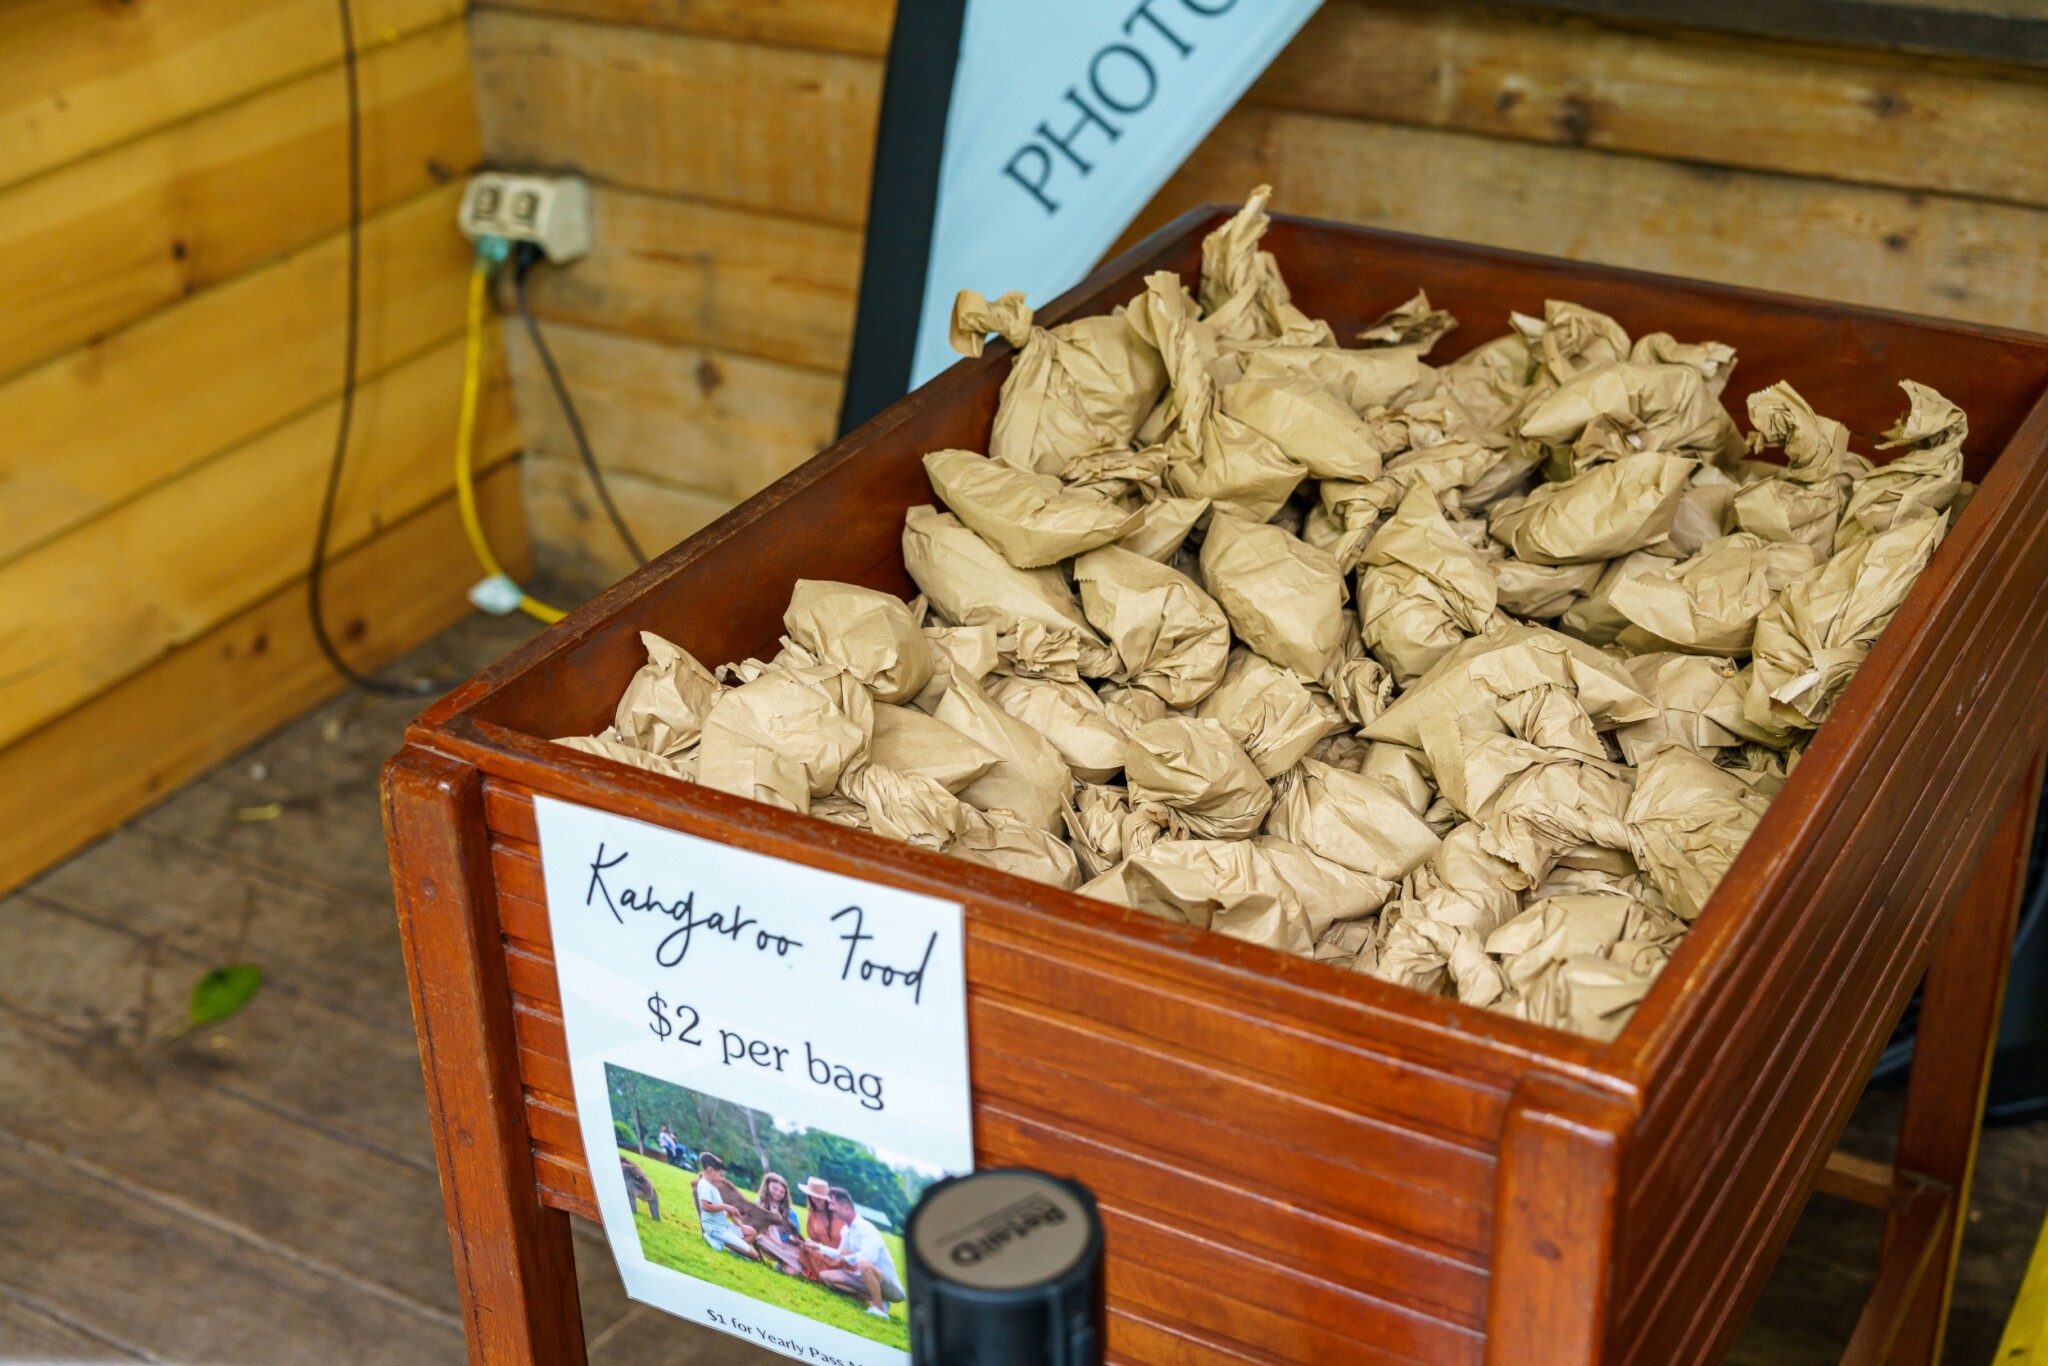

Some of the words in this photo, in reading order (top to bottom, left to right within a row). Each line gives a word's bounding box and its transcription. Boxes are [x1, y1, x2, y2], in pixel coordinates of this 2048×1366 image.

[1001, 0, 1241, 216] PHOT
[585, 842, 804, 968] Kangaroo
[830, 905, 938, 1005] Food
[647, 991, 702, 1046] $2
[719, 1029, 790, 1072] per
[804, 1041, 884, 1111] bag
[706, 1308, 728, 1325] $1
[731, 1317, 753, 1335] for
[756, 1326, 805, 1356] Yearly
[808, 1346, 844, 1366] Pass
